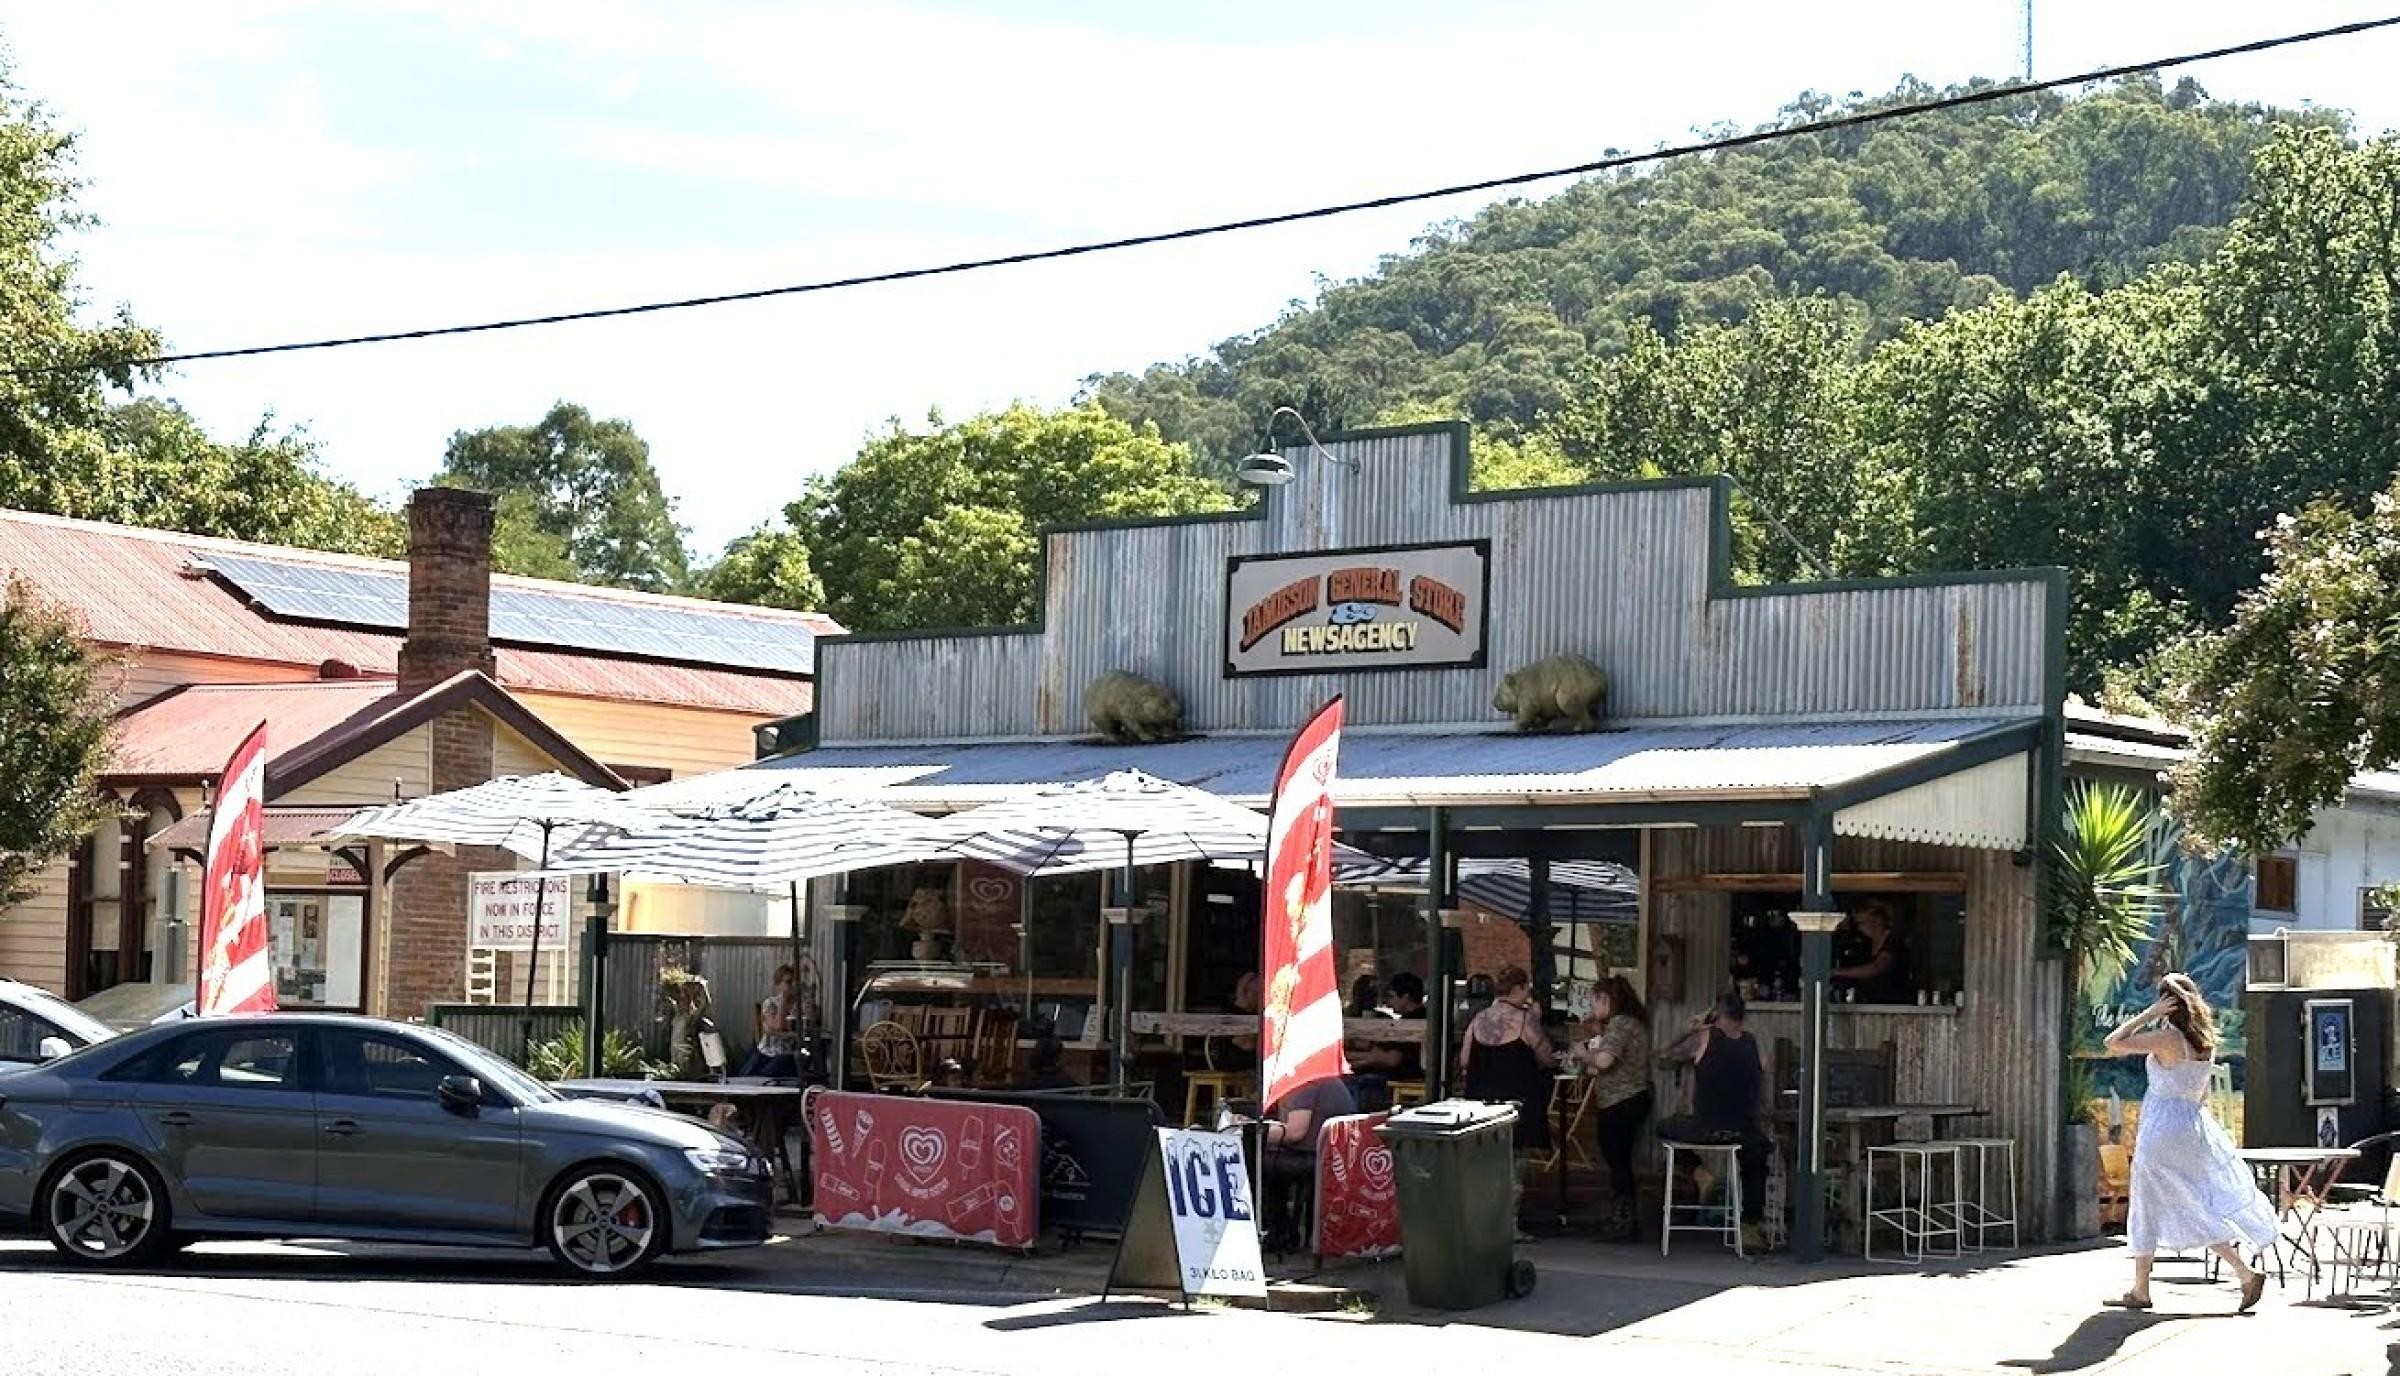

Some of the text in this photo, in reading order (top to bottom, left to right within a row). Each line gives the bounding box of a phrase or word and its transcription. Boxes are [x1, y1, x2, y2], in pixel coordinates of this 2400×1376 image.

[1240, 567, 1466, 651] JAMIESON GENERAL STORE
[1283, 622, 1418, 655] NEWSAGENCY
[330, 868, 363, 881] CLOSE
[475, 880, 568, 895] FIRE RESTRICIONS
[485, 902, 555, 917] NOW IN FOCE
[479, 925, 489, 939] IN
[492, 925, 514, 939] THIS
[1166, 1137, 1252, 1220] ICE
